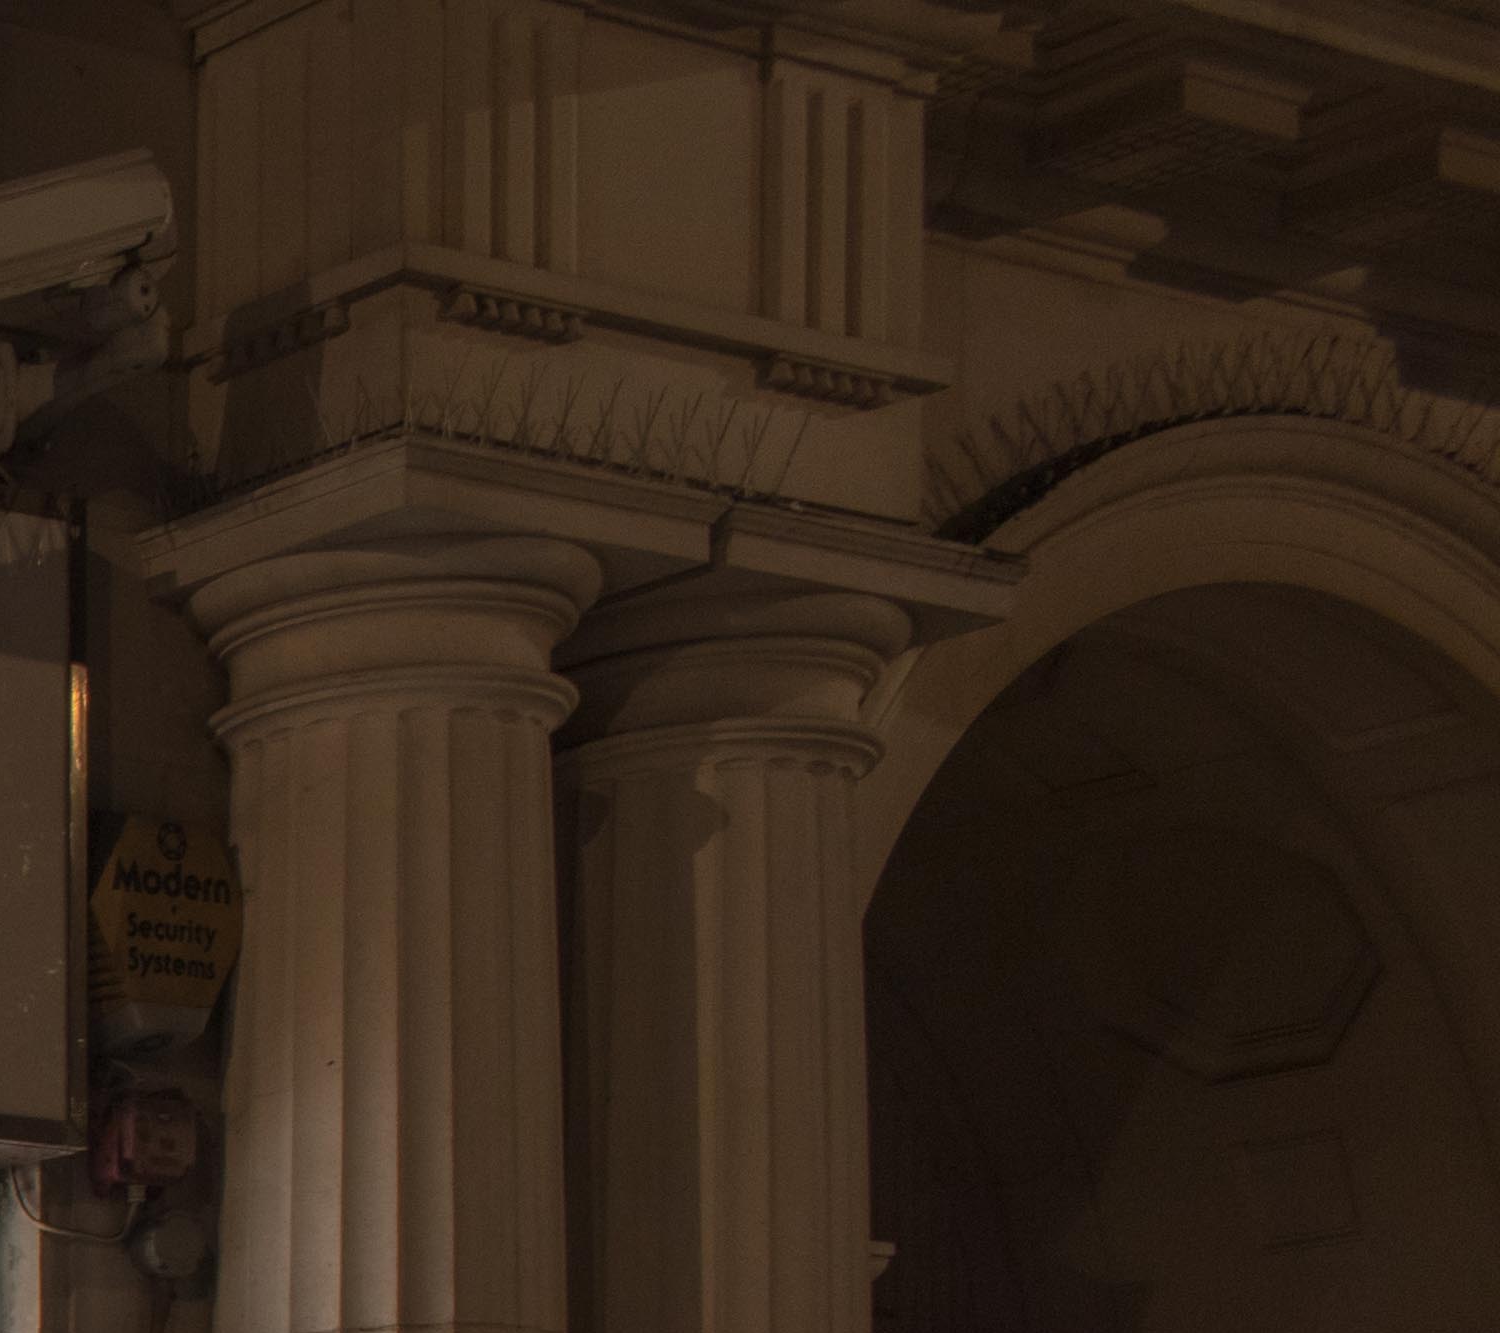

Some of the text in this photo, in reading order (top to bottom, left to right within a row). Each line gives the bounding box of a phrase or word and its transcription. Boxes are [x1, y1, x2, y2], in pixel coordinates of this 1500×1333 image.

[112, 854, 231, 904] Modern
[126, 912, 217, 952] Security
[126, 945, 216, 980] Systems
